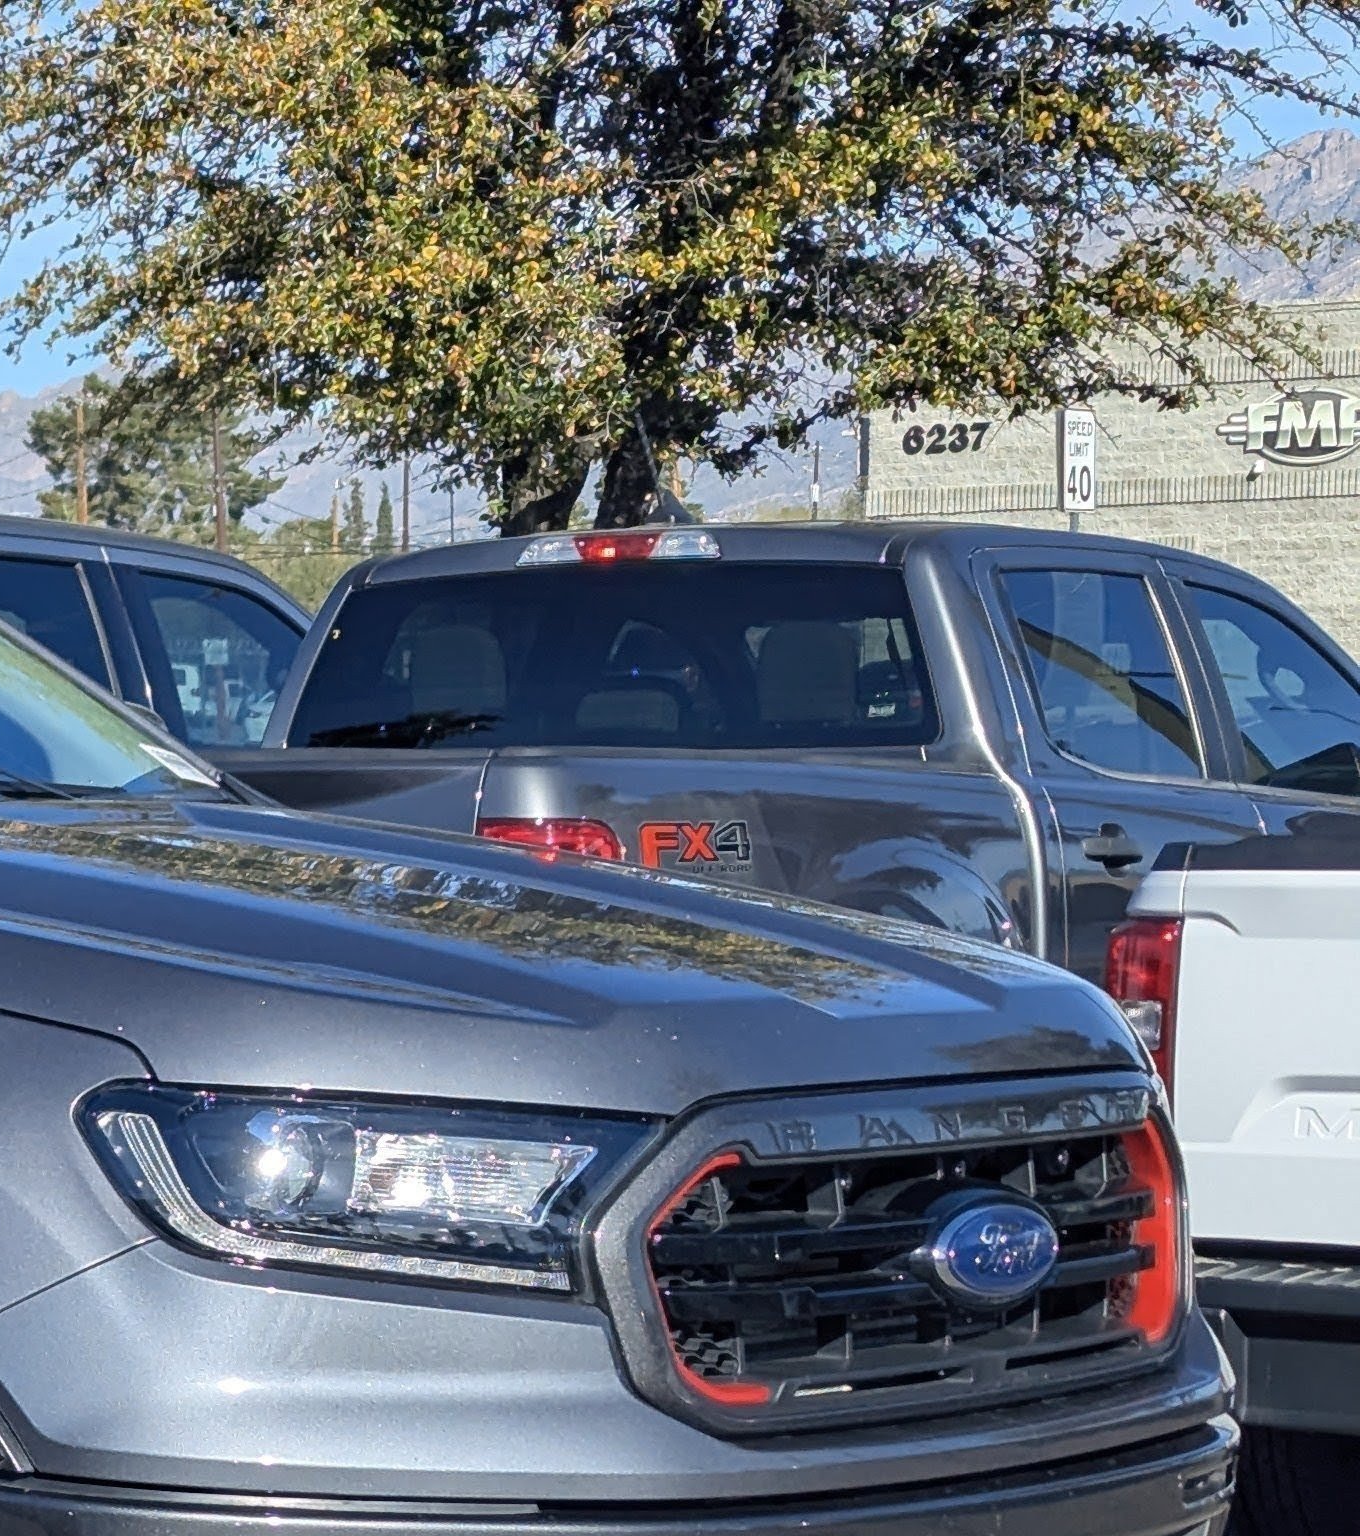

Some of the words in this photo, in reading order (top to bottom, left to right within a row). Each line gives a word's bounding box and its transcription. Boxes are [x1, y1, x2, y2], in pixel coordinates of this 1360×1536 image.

[902, 421, 993, 456] 6237
[1067, 420, 1093, 437] SPEED
[1069, 442, 1090, 457] LIMIT
[1067, 465, 1092, 502] 40
[638, 820, 753, 869] FX4
